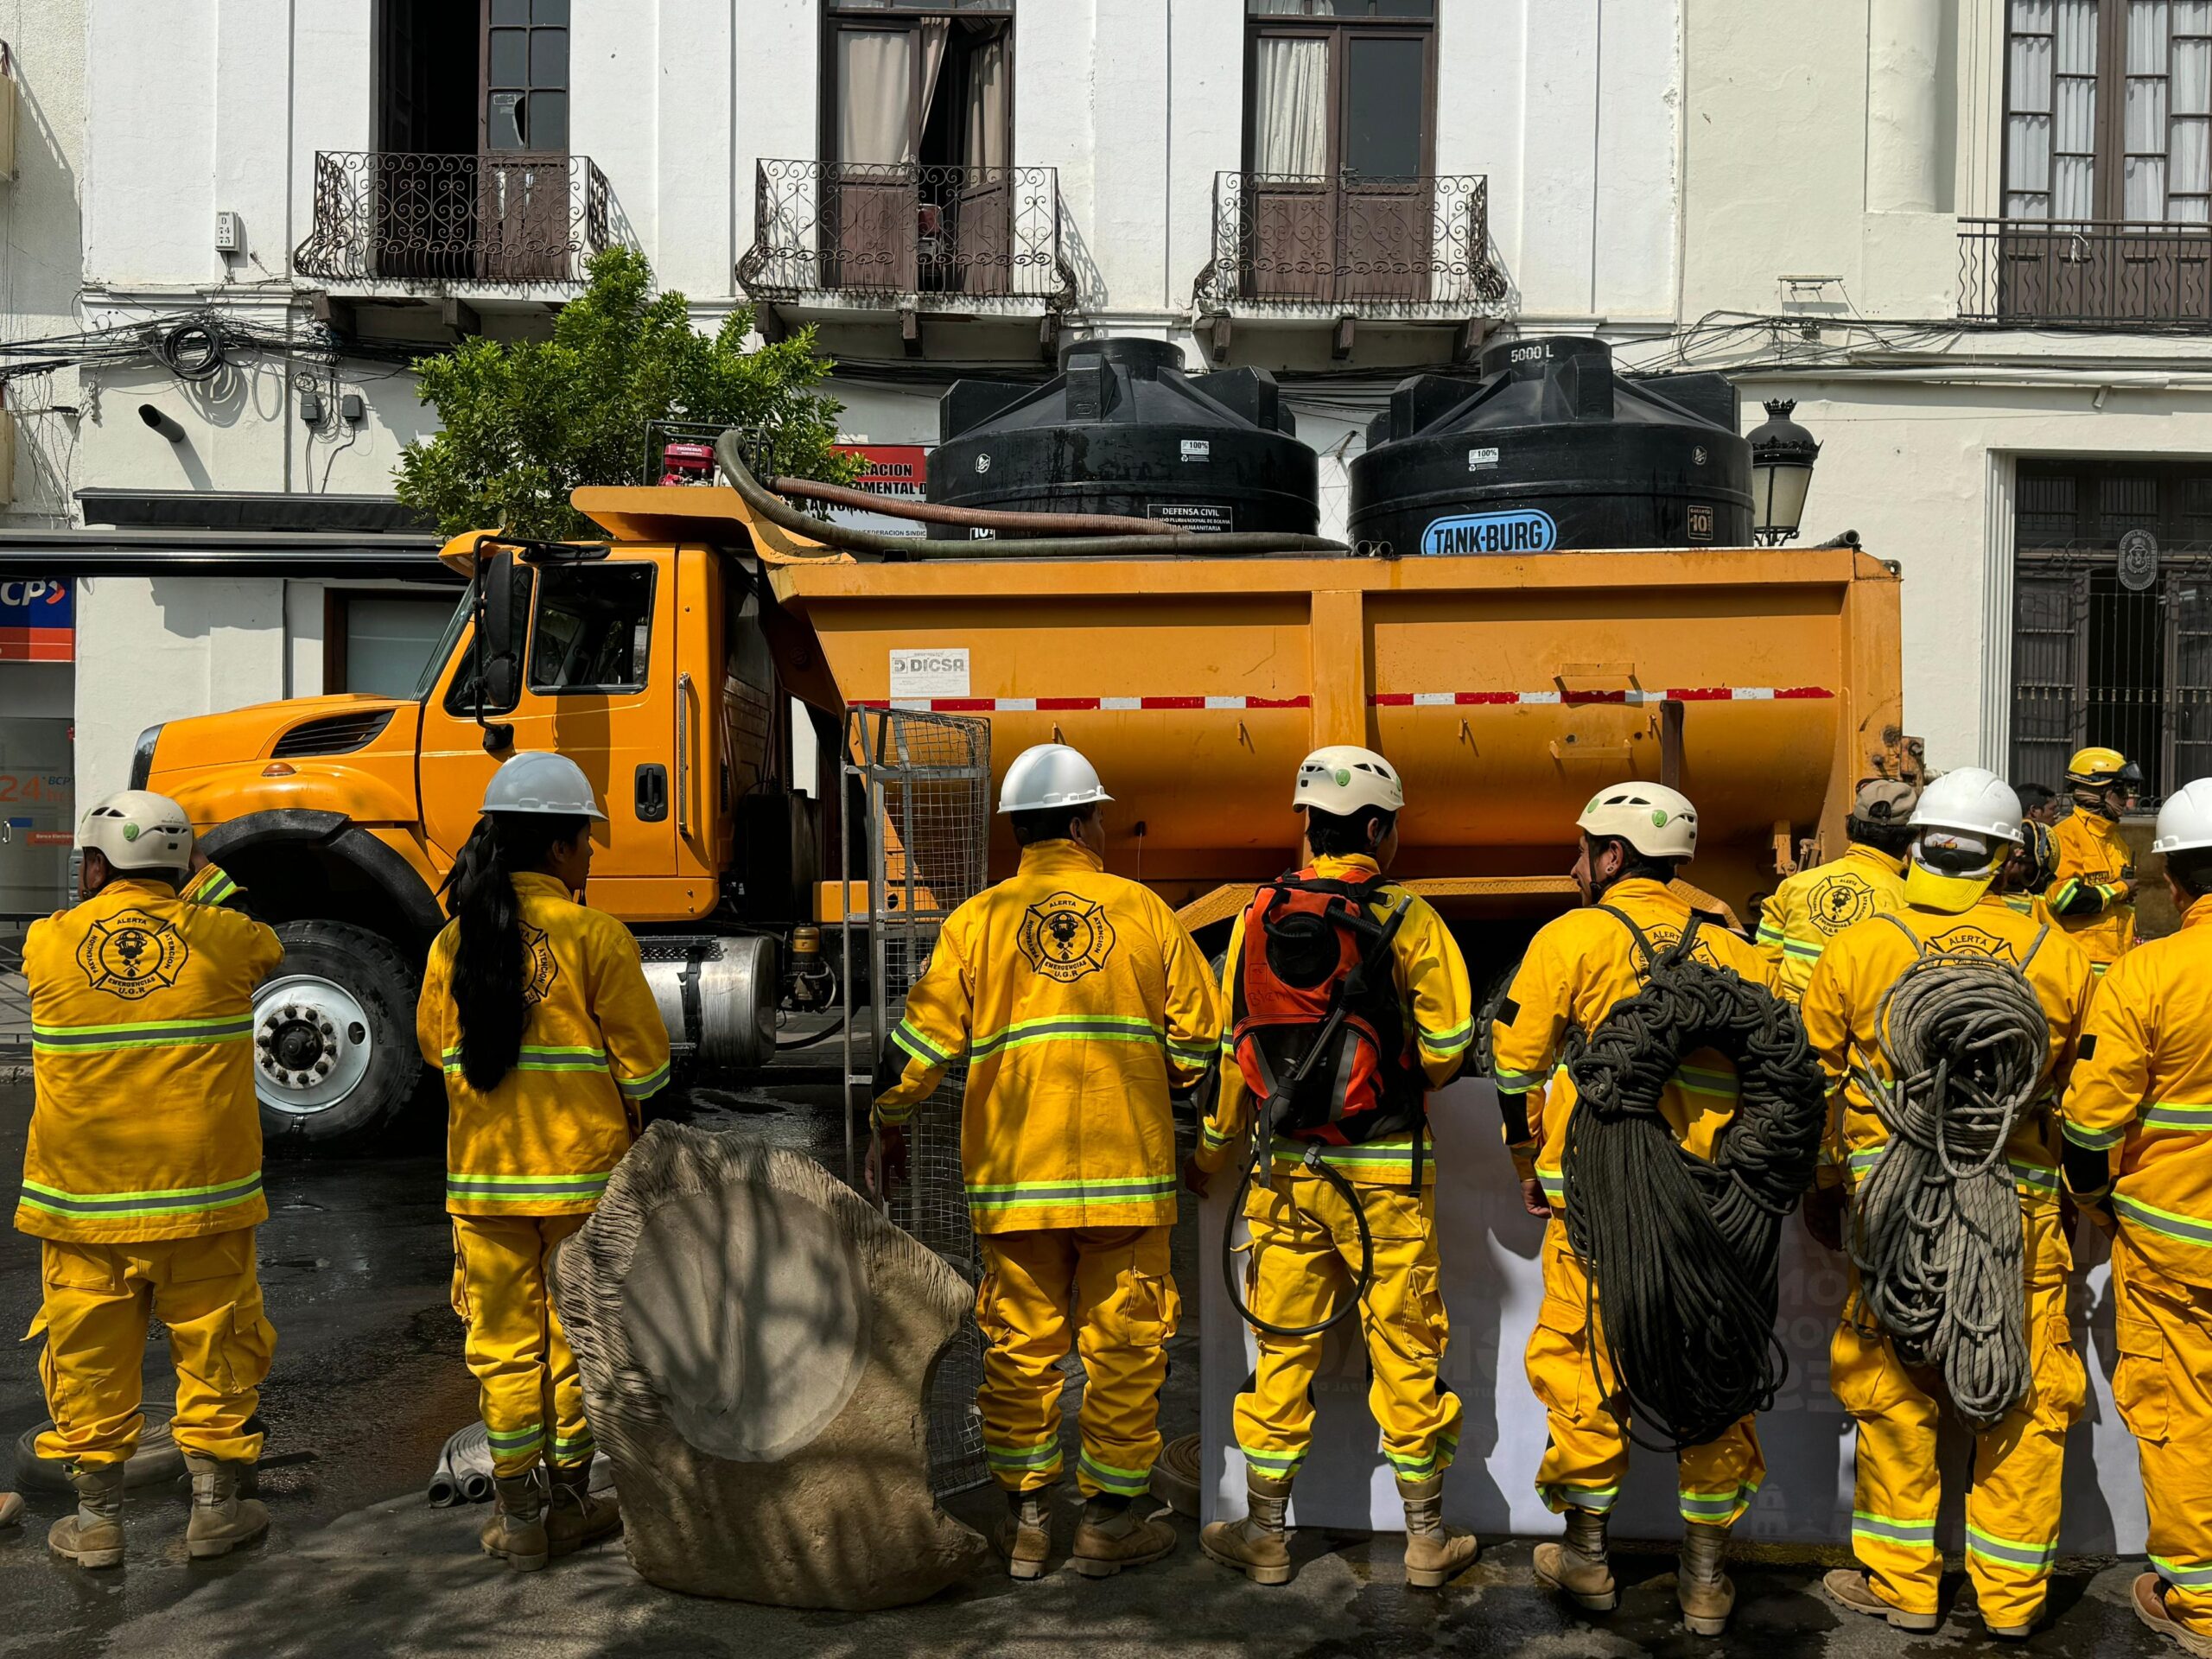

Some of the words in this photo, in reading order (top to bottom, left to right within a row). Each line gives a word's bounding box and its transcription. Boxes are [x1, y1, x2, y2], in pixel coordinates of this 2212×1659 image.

[1510, 346, 1542, 363] 5000
[1545, 344, 1554, 358] L
[1162, 507, 1199, 516] DEFENSA
[1200, 508, 1220, 517] CIVIL
[1690, 514, 1707, 532] 10
[1433, 520, 1543, 554] TANK-BURG
[910, 658, 964, 672] DICSA
[0, 775, 40, 802] 24
[48, 776, 71, 785] BCP
[1049, 899, 1077, 908] ALERTA
[117, 917, 147, 925] ALERTA
[1026, 919, 1039, 959] PREVENCION
[1093, 917, 1104, 954] ATENCION
[1653, 931, 1681, 941] ALERT
[1949, 935, 1987, 946] ALERTA
[86, 935, 99, 973] PREVENCION
[164, 933, 175, 969] ATENCION
[537, 948, 550, 984] ATENCION
[1044, 960, 1087, 971] EMERGENCIAS
[107, 976, 156, 988] EMERGENCIAS
